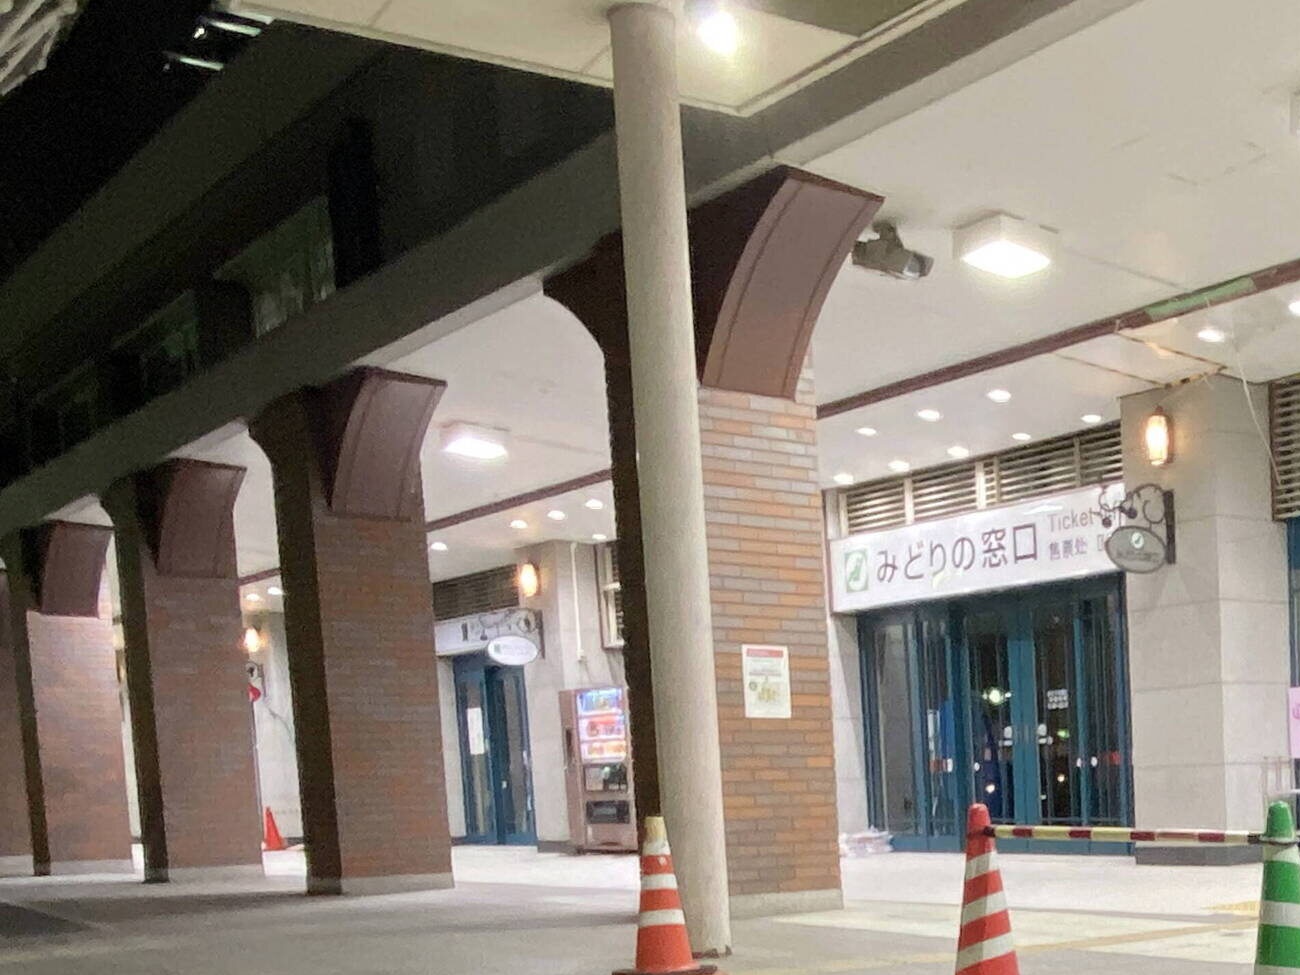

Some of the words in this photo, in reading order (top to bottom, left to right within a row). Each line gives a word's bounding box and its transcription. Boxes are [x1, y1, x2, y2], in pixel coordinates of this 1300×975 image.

[876, 523, 1037, 584] みどりの窓口
